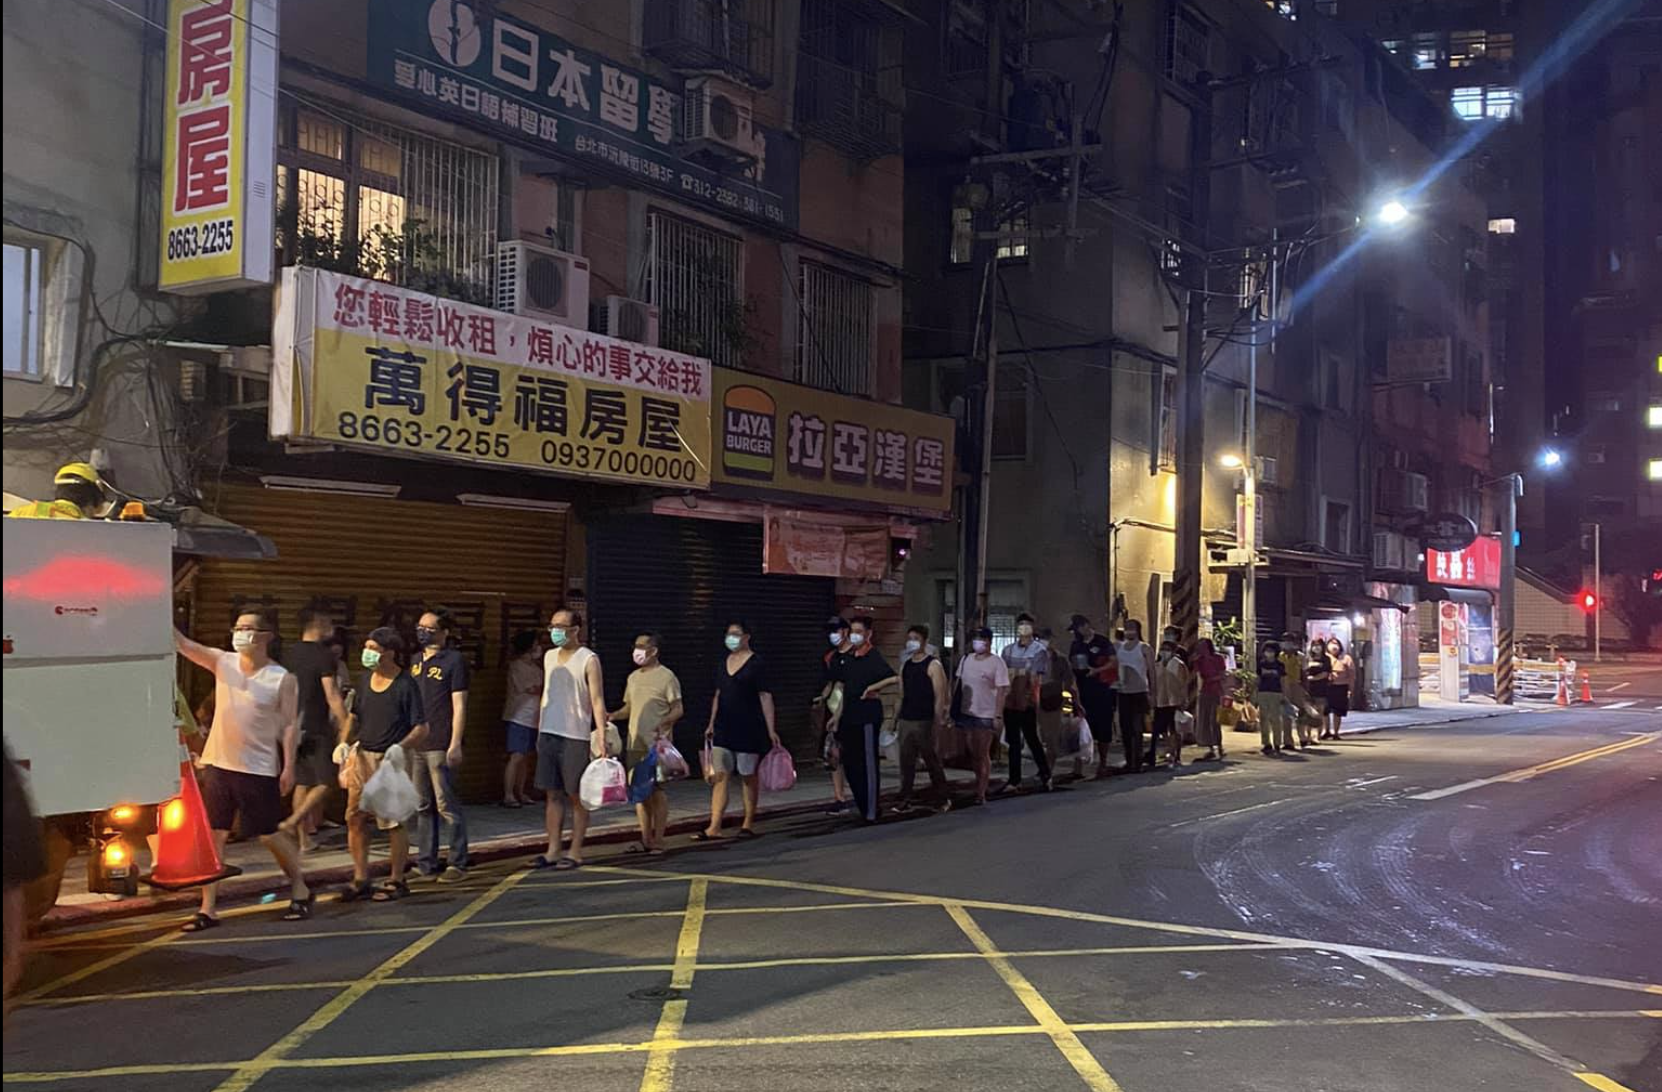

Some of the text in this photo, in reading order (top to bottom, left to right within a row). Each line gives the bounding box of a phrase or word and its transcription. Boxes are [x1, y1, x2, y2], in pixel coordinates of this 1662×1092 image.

[167, 219, 234, 262] 8663-2255
[364, 345, 683, 453] 萬得福房屋
[726, 412, 772, 439] LAYA
[338, 411, 697, 483] 8663-2255 0937000000
[725, 434, 773, 456] BURGER
[788, 412, 945, 492] 拉亞漢堡
